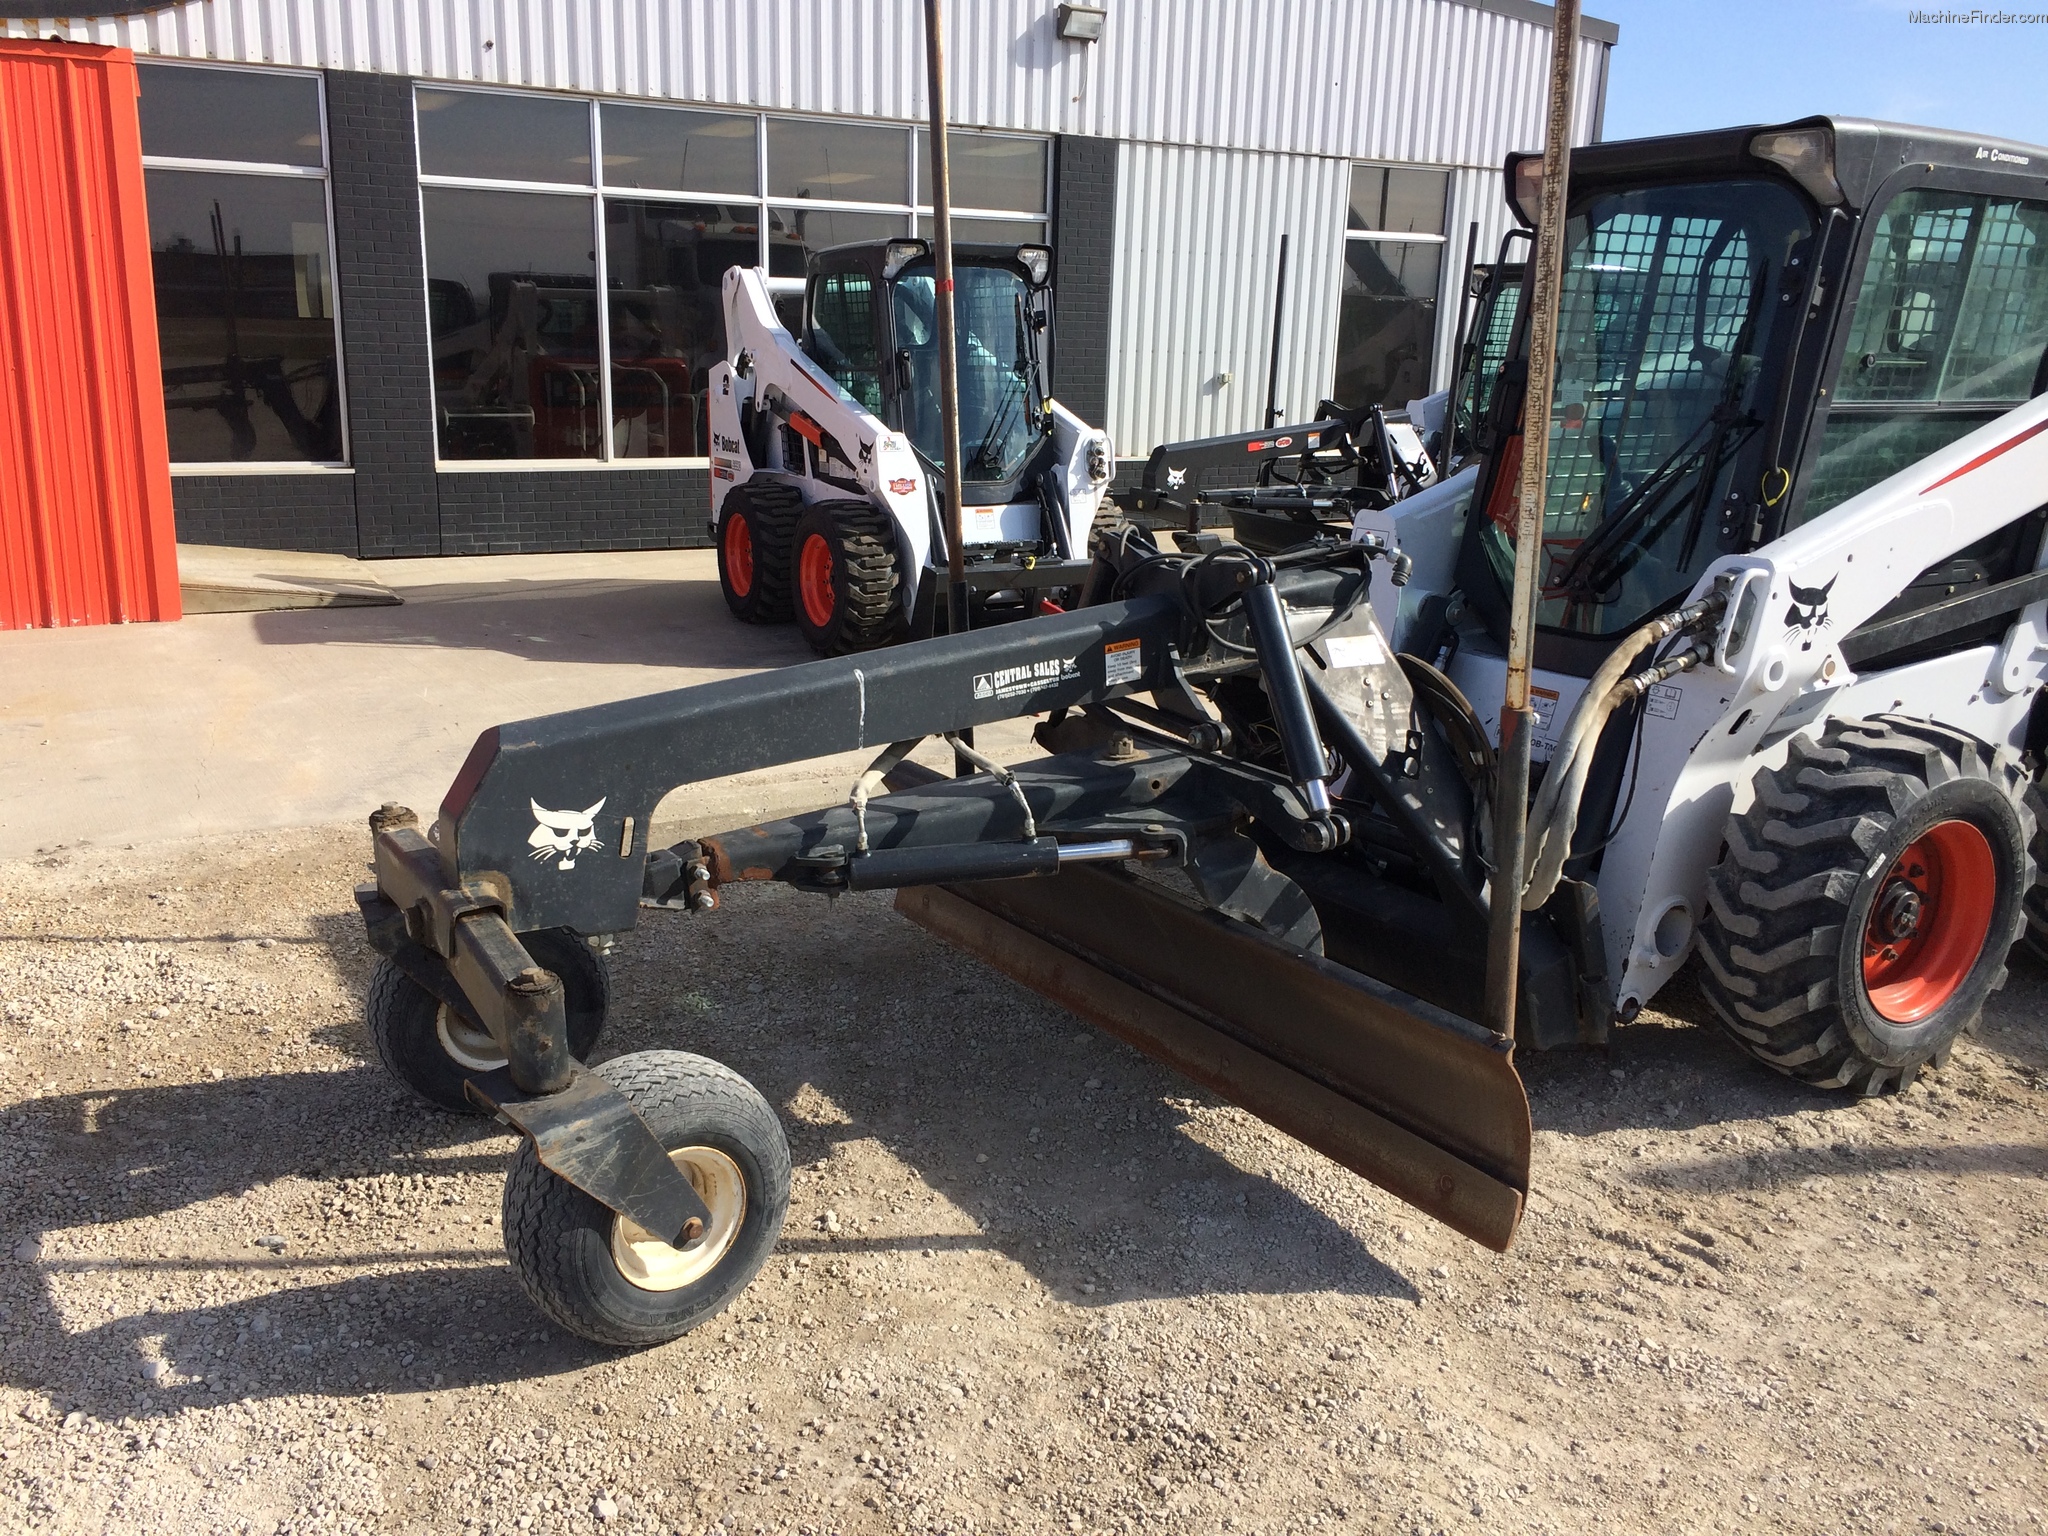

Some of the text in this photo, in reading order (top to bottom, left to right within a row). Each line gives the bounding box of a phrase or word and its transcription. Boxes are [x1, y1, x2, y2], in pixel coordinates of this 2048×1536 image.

[722, 436, 740, 454] Bobcat
[994, 658, 1060, 689] CENTRAL SALES
